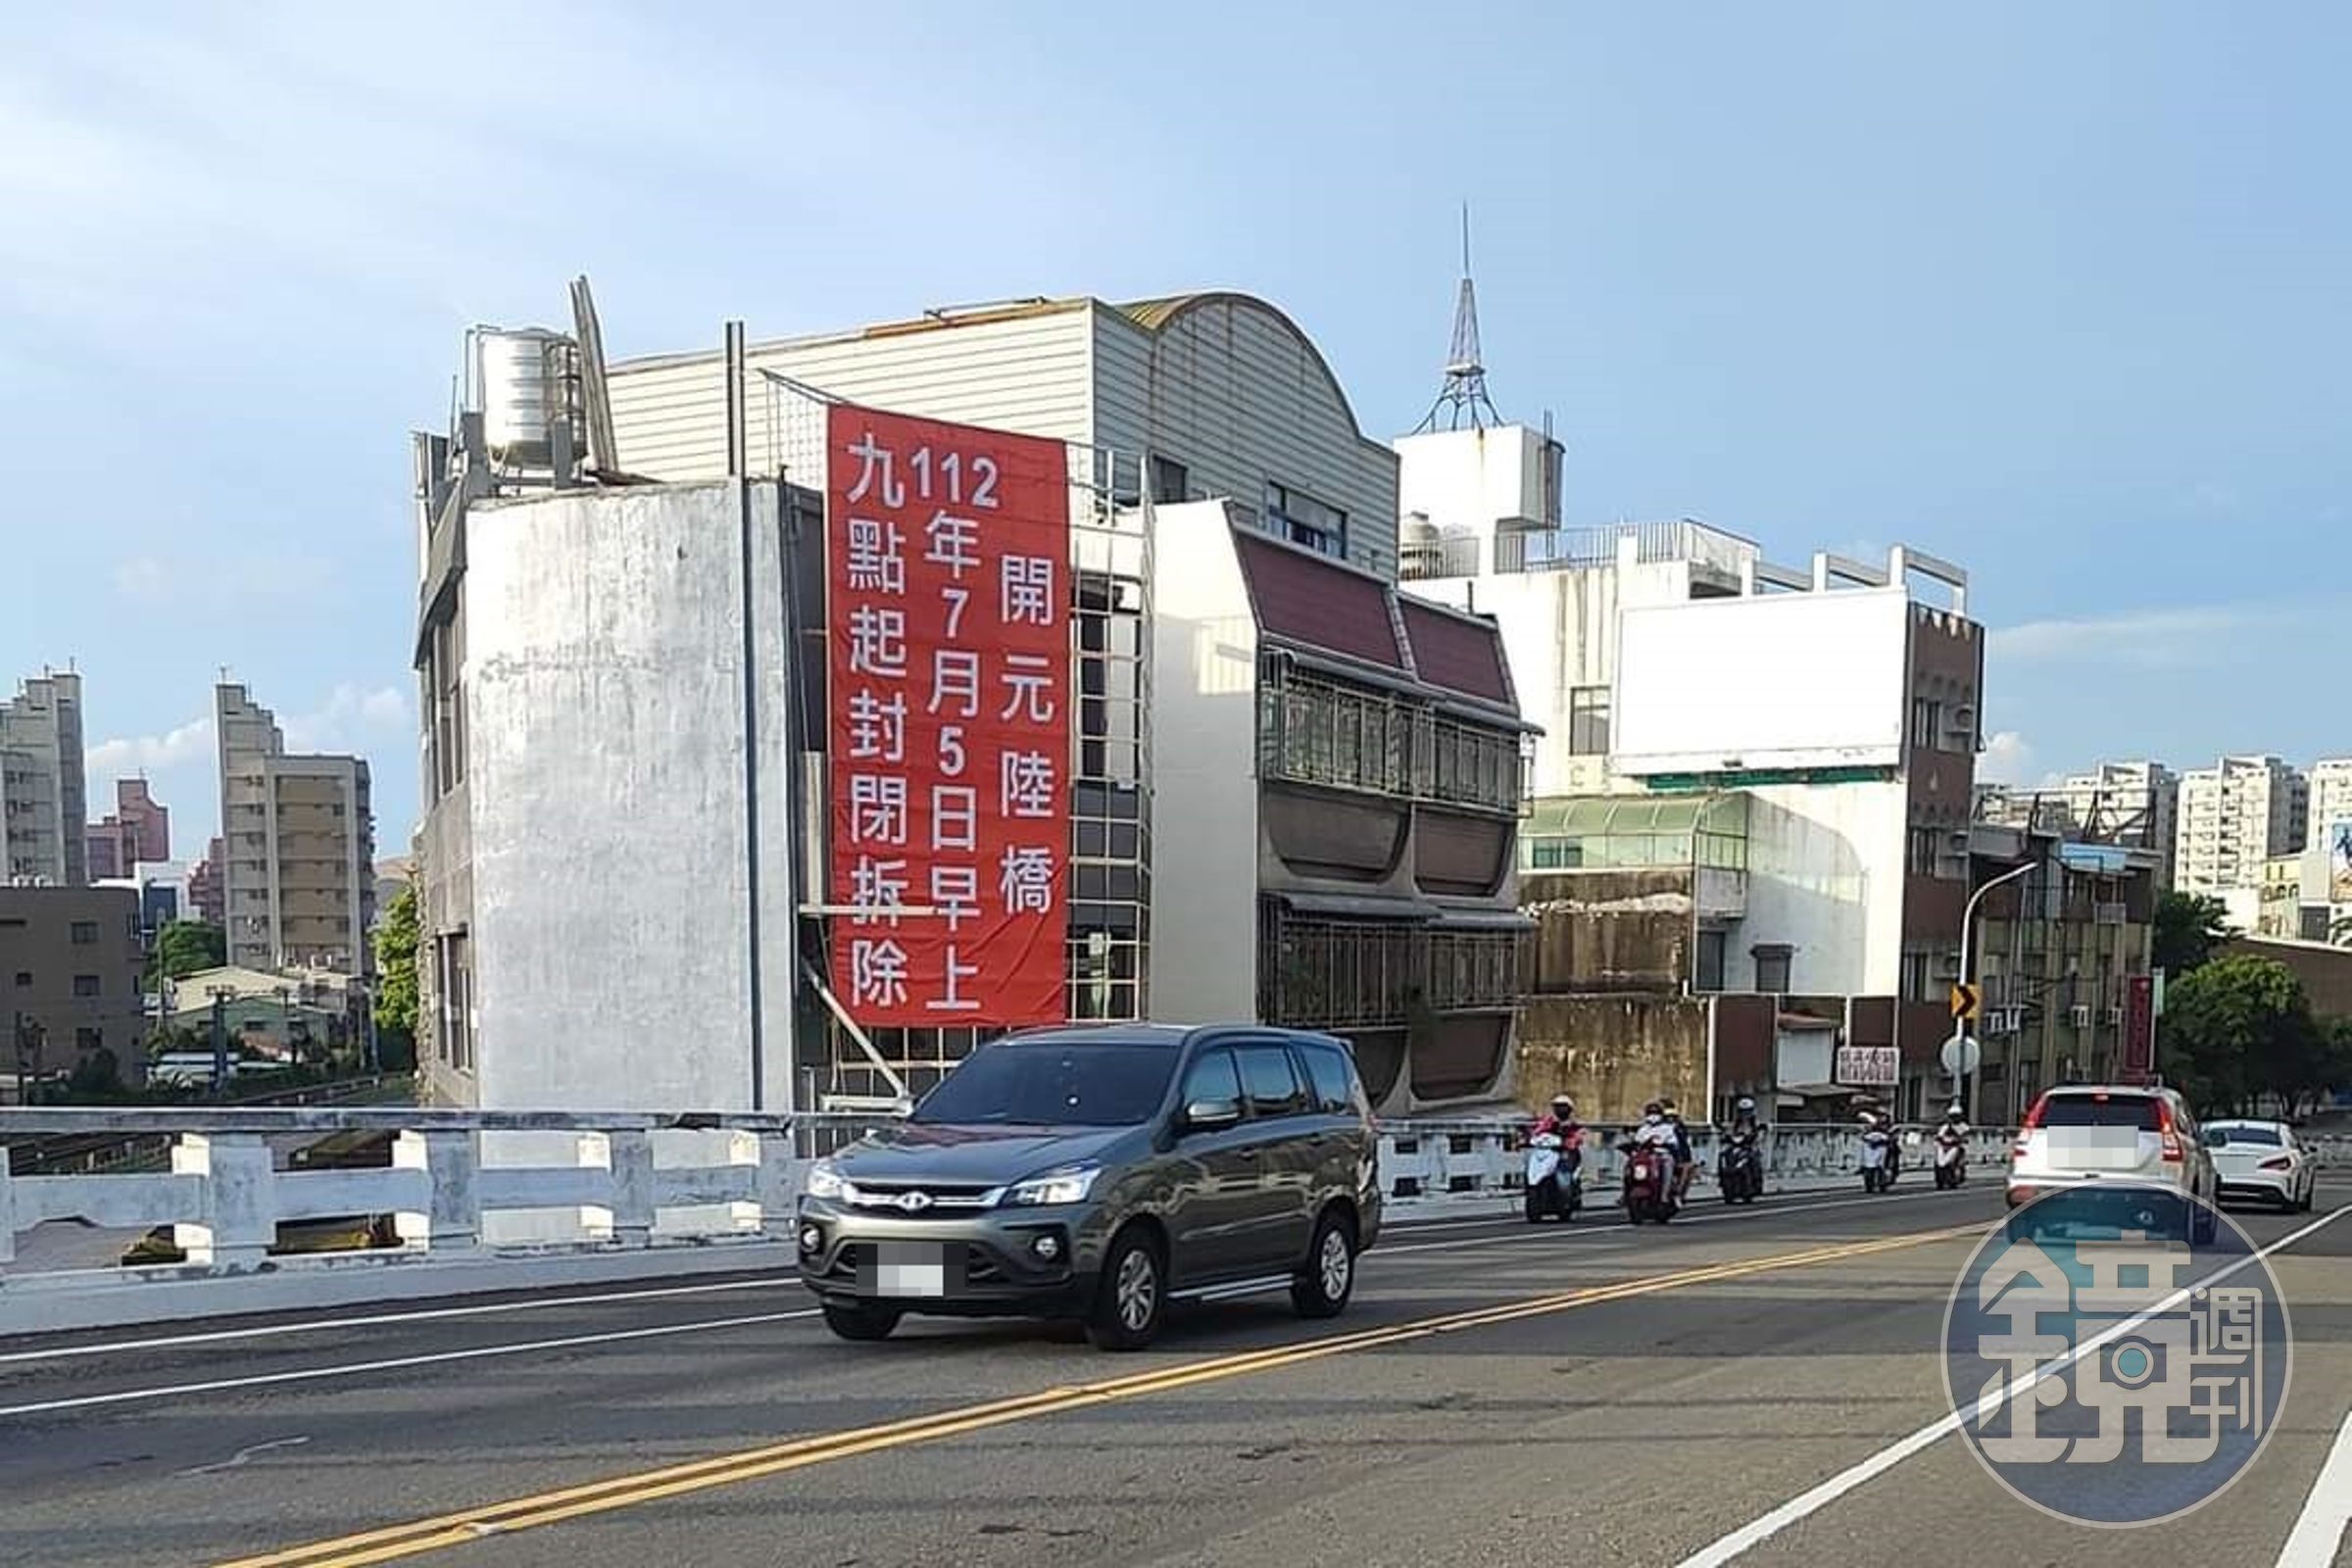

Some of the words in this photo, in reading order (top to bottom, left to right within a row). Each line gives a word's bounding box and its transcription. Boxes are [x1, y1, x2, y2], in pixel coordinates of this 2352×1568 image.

[847, 432, 909, 1008] 九點起封閉拆除
[1000, 554, 1054, 915] 開元陸橋
